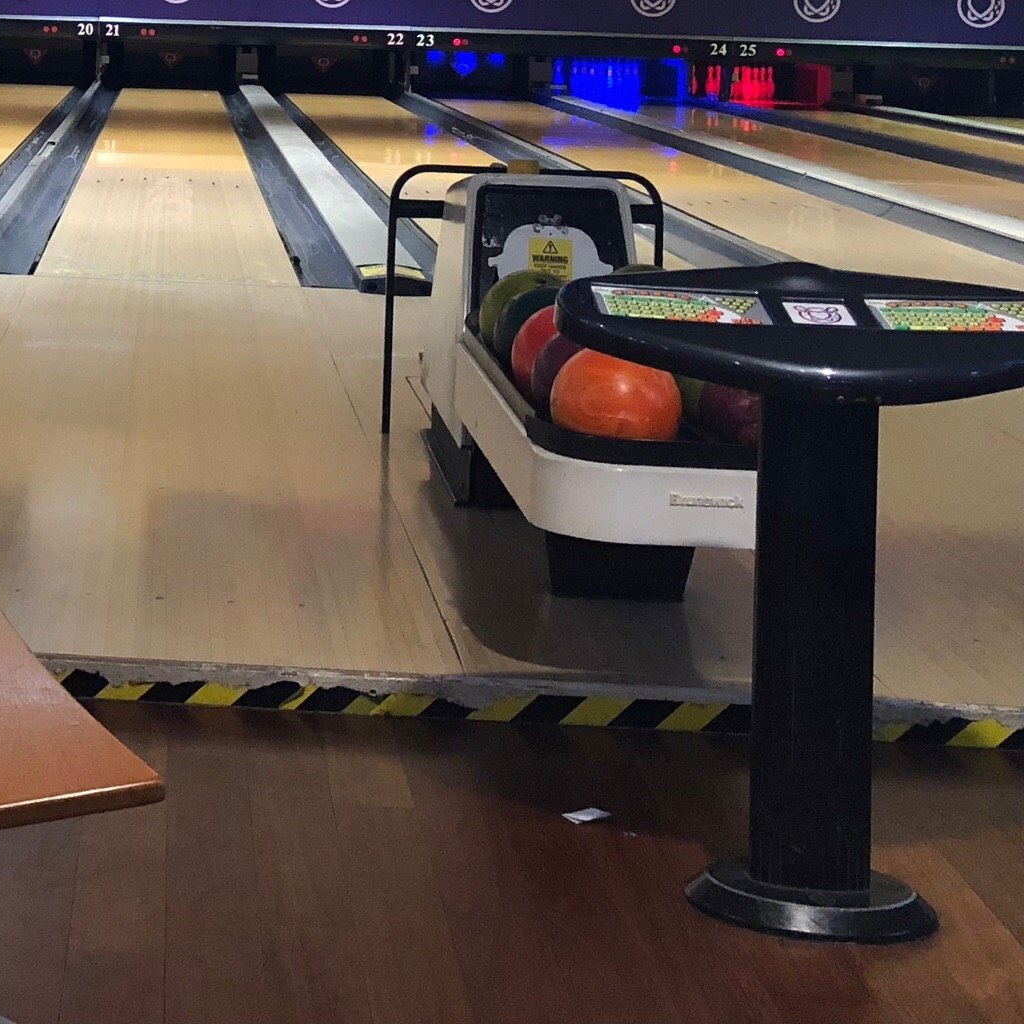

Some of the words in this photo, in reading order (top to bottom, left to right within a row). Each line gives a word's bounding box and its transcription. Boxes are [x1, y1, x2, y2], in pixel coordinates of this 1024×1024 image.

[77, 23, 94, 36] 20
[105, 24, 120, 36] 21
[387, 33, 404, 45] 22
[416, 34, 435, 47] 23
[710, 43, 727, 56] 24
[739, 44, 757, 57] 25
[532, 254, 568, 264] WARNING
[669, 492, 744, 509] Brunswick
